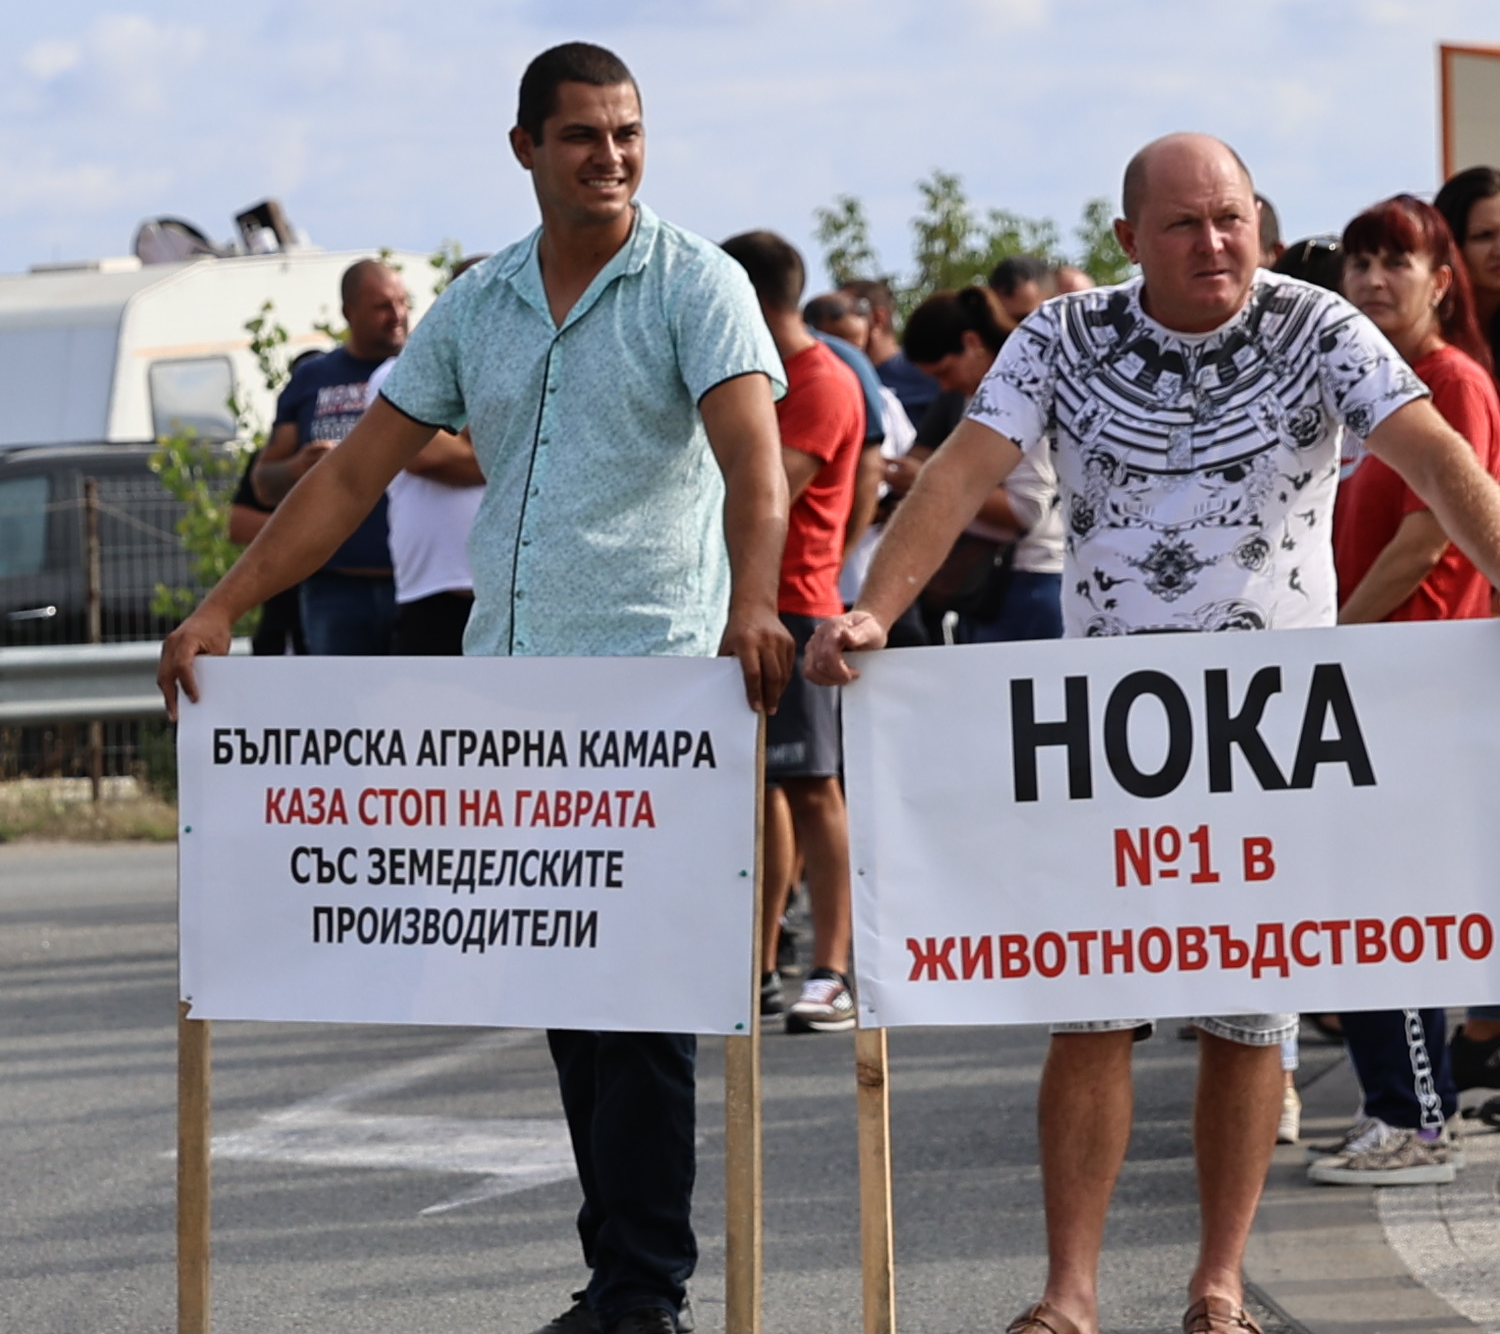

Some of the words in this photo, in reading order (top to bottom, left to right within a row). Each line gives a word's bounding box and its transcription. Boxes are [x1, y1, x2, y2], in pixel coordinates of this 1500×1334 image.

[212, 728, 407, 766] БЪЛГАРСКА
[416, 729, 569, 768] АГРАРНА
[579, 729, 717, 769] КАМАРА
[1009, 662, 1378, 803] НОКА
[264, 786, 349, 826] КАЗА
[357, 787, 447, 827] СТОП
[459, 789, 504, 828] НА
[514, 789, 657, 829] ГАВРАТА
[290, 845, 358, 885] СЪС
[367, 846, 624, 894] ЗЕМЕДЕЛСКИТЕ
[1113, 823, 1220, 888] №1
[312, 905, 599, 954] ПРОИЗВОДИТЕЛИ
[905, 912, 1495, 981] ЖИВОТНОВЪДСТВОТО
